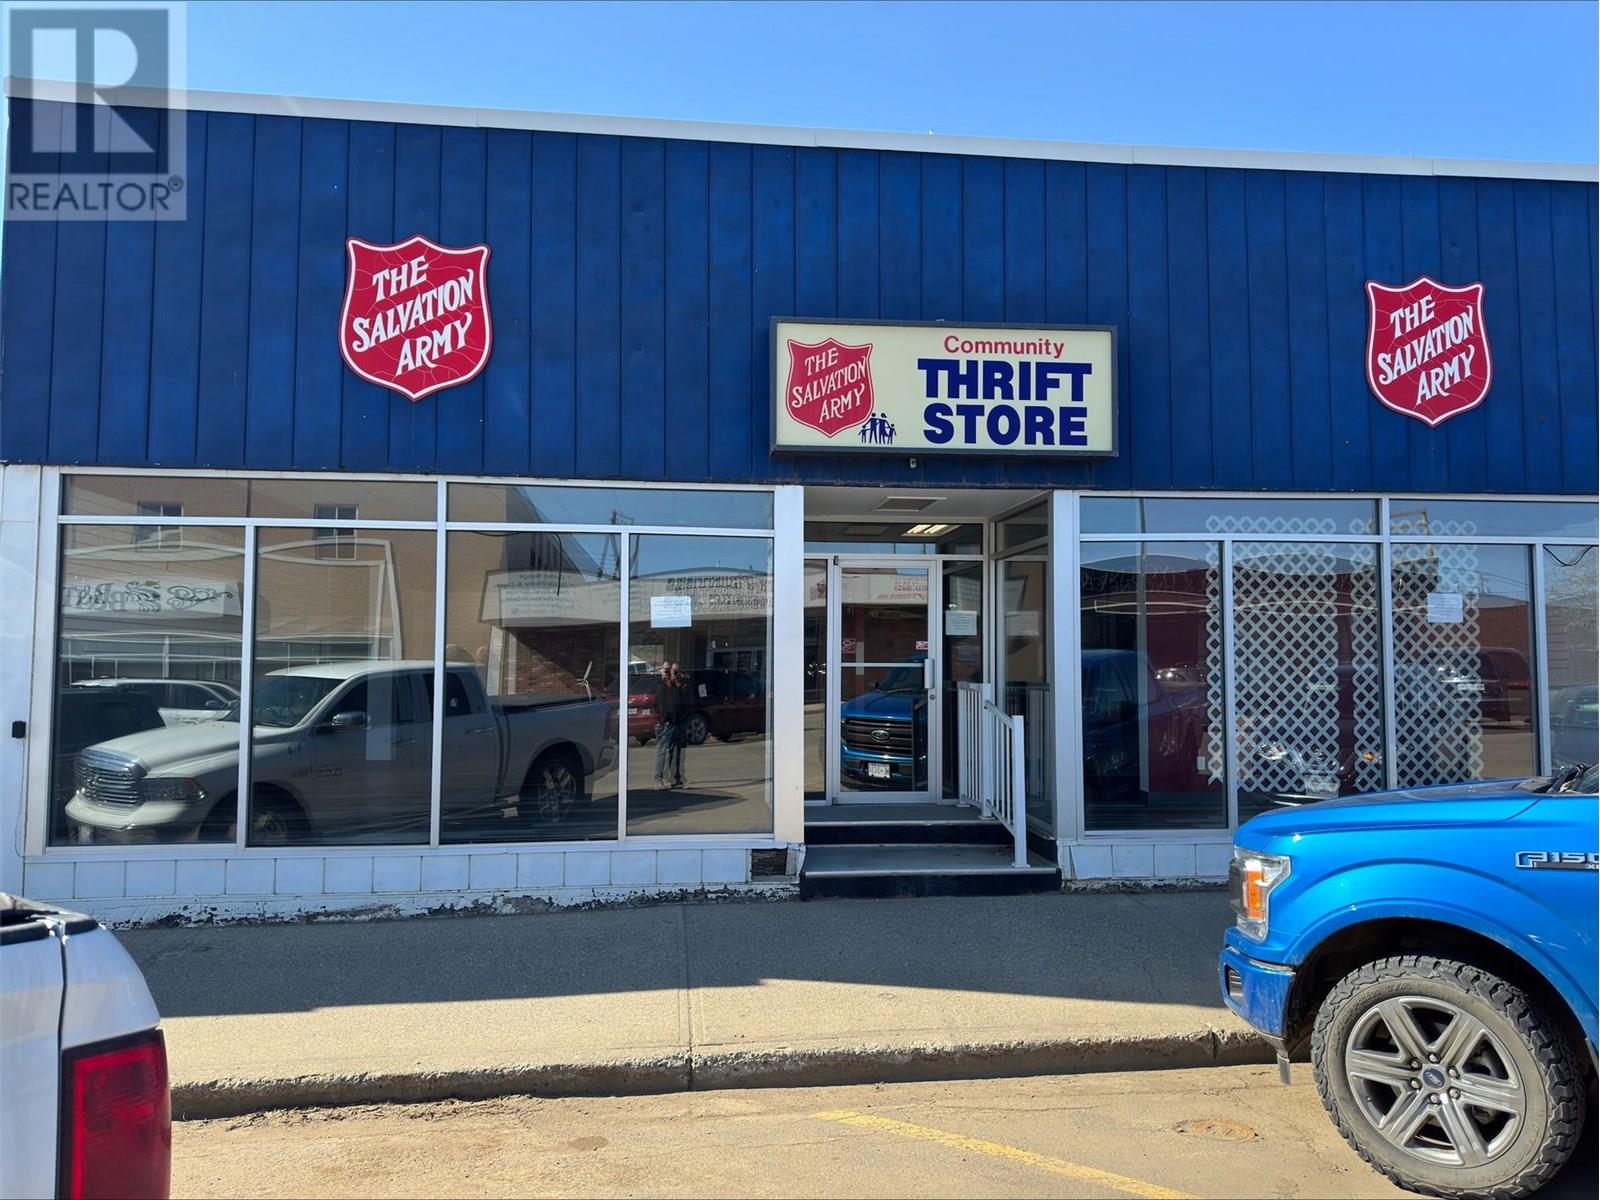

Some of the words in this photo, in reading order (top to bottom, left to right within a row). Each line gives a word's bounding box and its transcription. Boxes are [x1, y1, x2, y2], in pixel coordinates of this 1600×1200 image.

[372, 255, 429, 302] THE
[352, 268, 474, 352] SALVATION
[1390, 294, 1436, 338] THE
[395, 312, 473, 376] ARMY
[804, 348, 839, 377] THE
[943, 335, 1064, 359] Community
[1377, 305, 1474, 385] SALVATION
[791, 355, 867, 408] SALVATION
[917, 358, 1093, 402] THRIFT
[1416, 344, 1475, 406] ARMY
[818, 383, 866, 424] ARMY
[923, 402, 1088, 446] STORE
